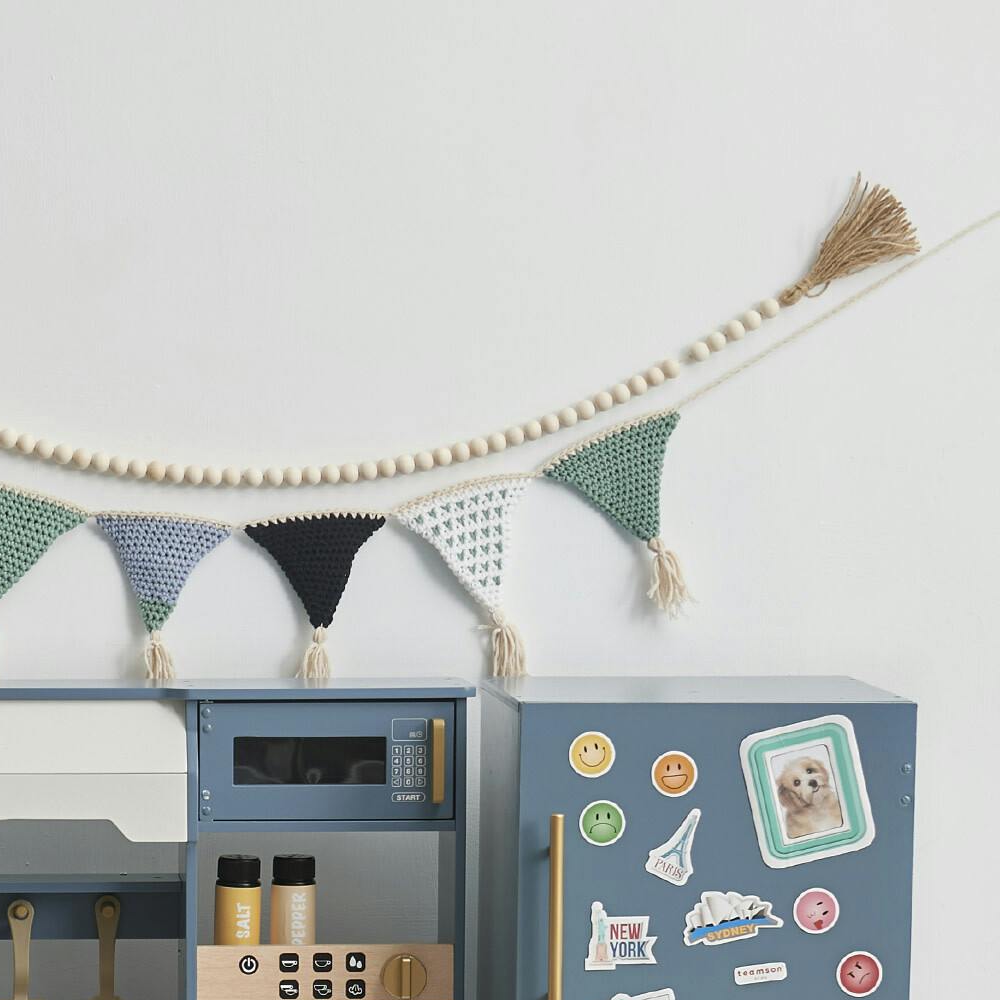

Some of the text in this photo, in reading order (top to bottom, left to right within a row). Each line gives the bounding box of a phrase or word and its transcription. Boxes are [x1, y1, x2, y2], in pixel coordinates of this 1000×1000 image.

[654, 858, 683, 879] PARIS
[236, 902, 251, 939] SALT
[610, 923, 642, 940] NEW
[706, 924, 757, 941] SYDNEY
[610, 941, 646, 958] YORK
[737, 966, 783, 977] teamson
